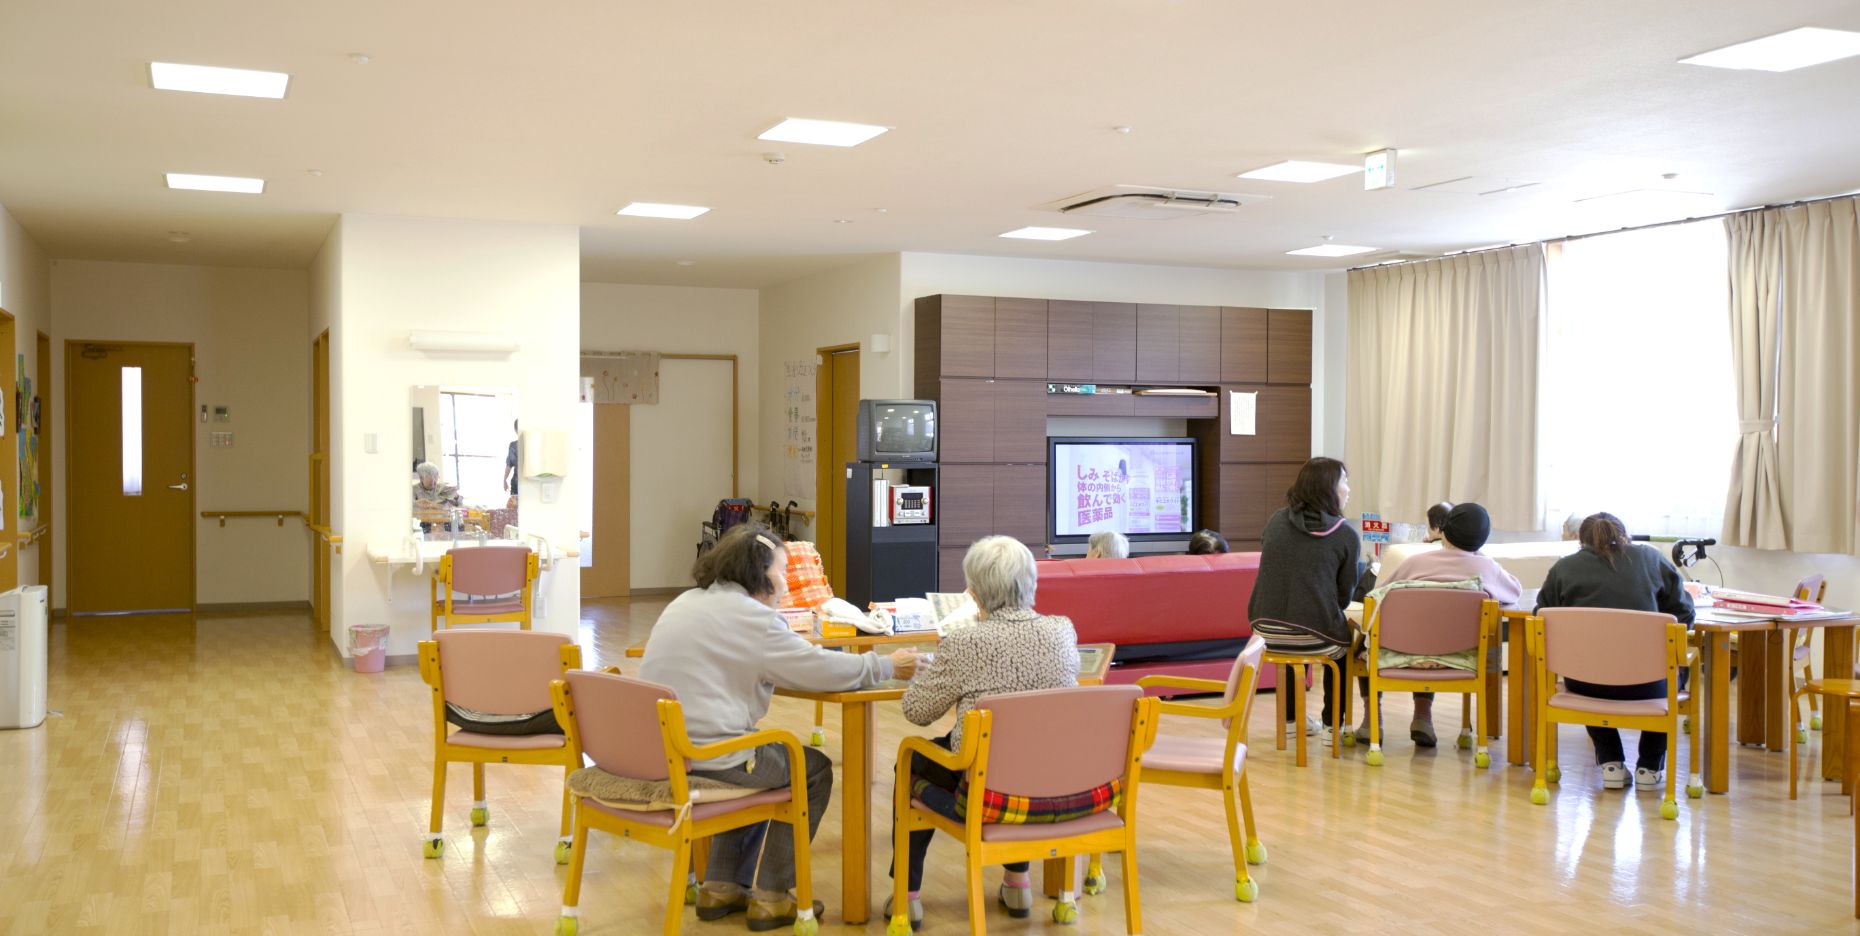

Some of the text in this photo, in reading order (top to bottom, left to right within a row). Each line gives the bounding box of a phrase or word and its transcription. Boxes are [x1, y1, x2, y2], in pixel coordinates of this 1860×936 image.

[1077, 481, 1121, 492] 体の内側から
[1077, 493, 1126, 509] 飲んで効く
[1077, 506, 1113, 527] 医薬品
